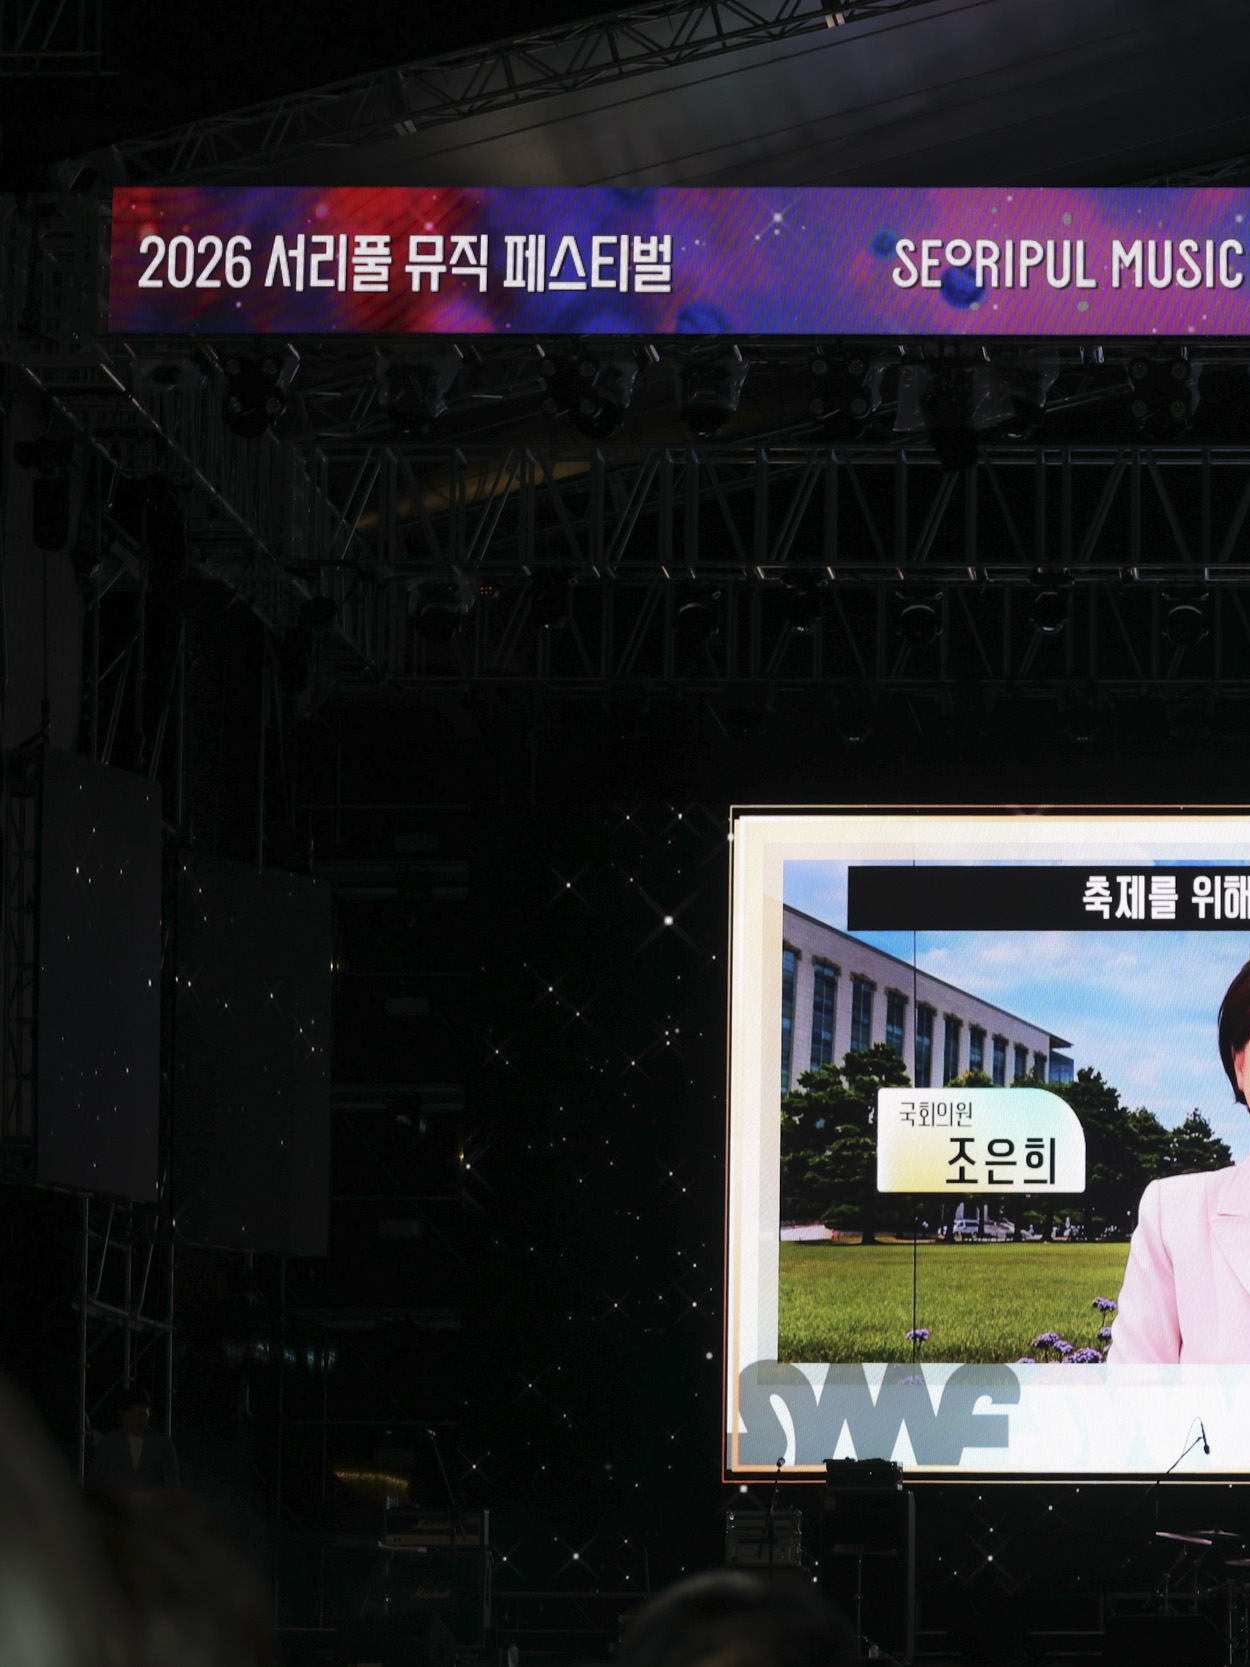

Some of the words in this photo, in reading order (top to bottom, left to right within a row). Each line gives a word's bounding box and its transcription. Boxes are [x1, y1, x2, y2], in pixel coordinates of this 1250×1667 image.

[138, 235, 252, 288] 2026
[264, 233, 392, 292] 서리풀
[405, 234, 488, 292] 뮤직
[503, 234, 672, 293] 페스티벌
[892, 238, 1096, 289] SEORIPUL
[1111, 238, 1244, 289] MUSIC
[1082, 875, 1179, 920] 축제를
[899, 1101, 973, 1128] 국회의원
[945, 1137, 1056, 1185] 조은희
